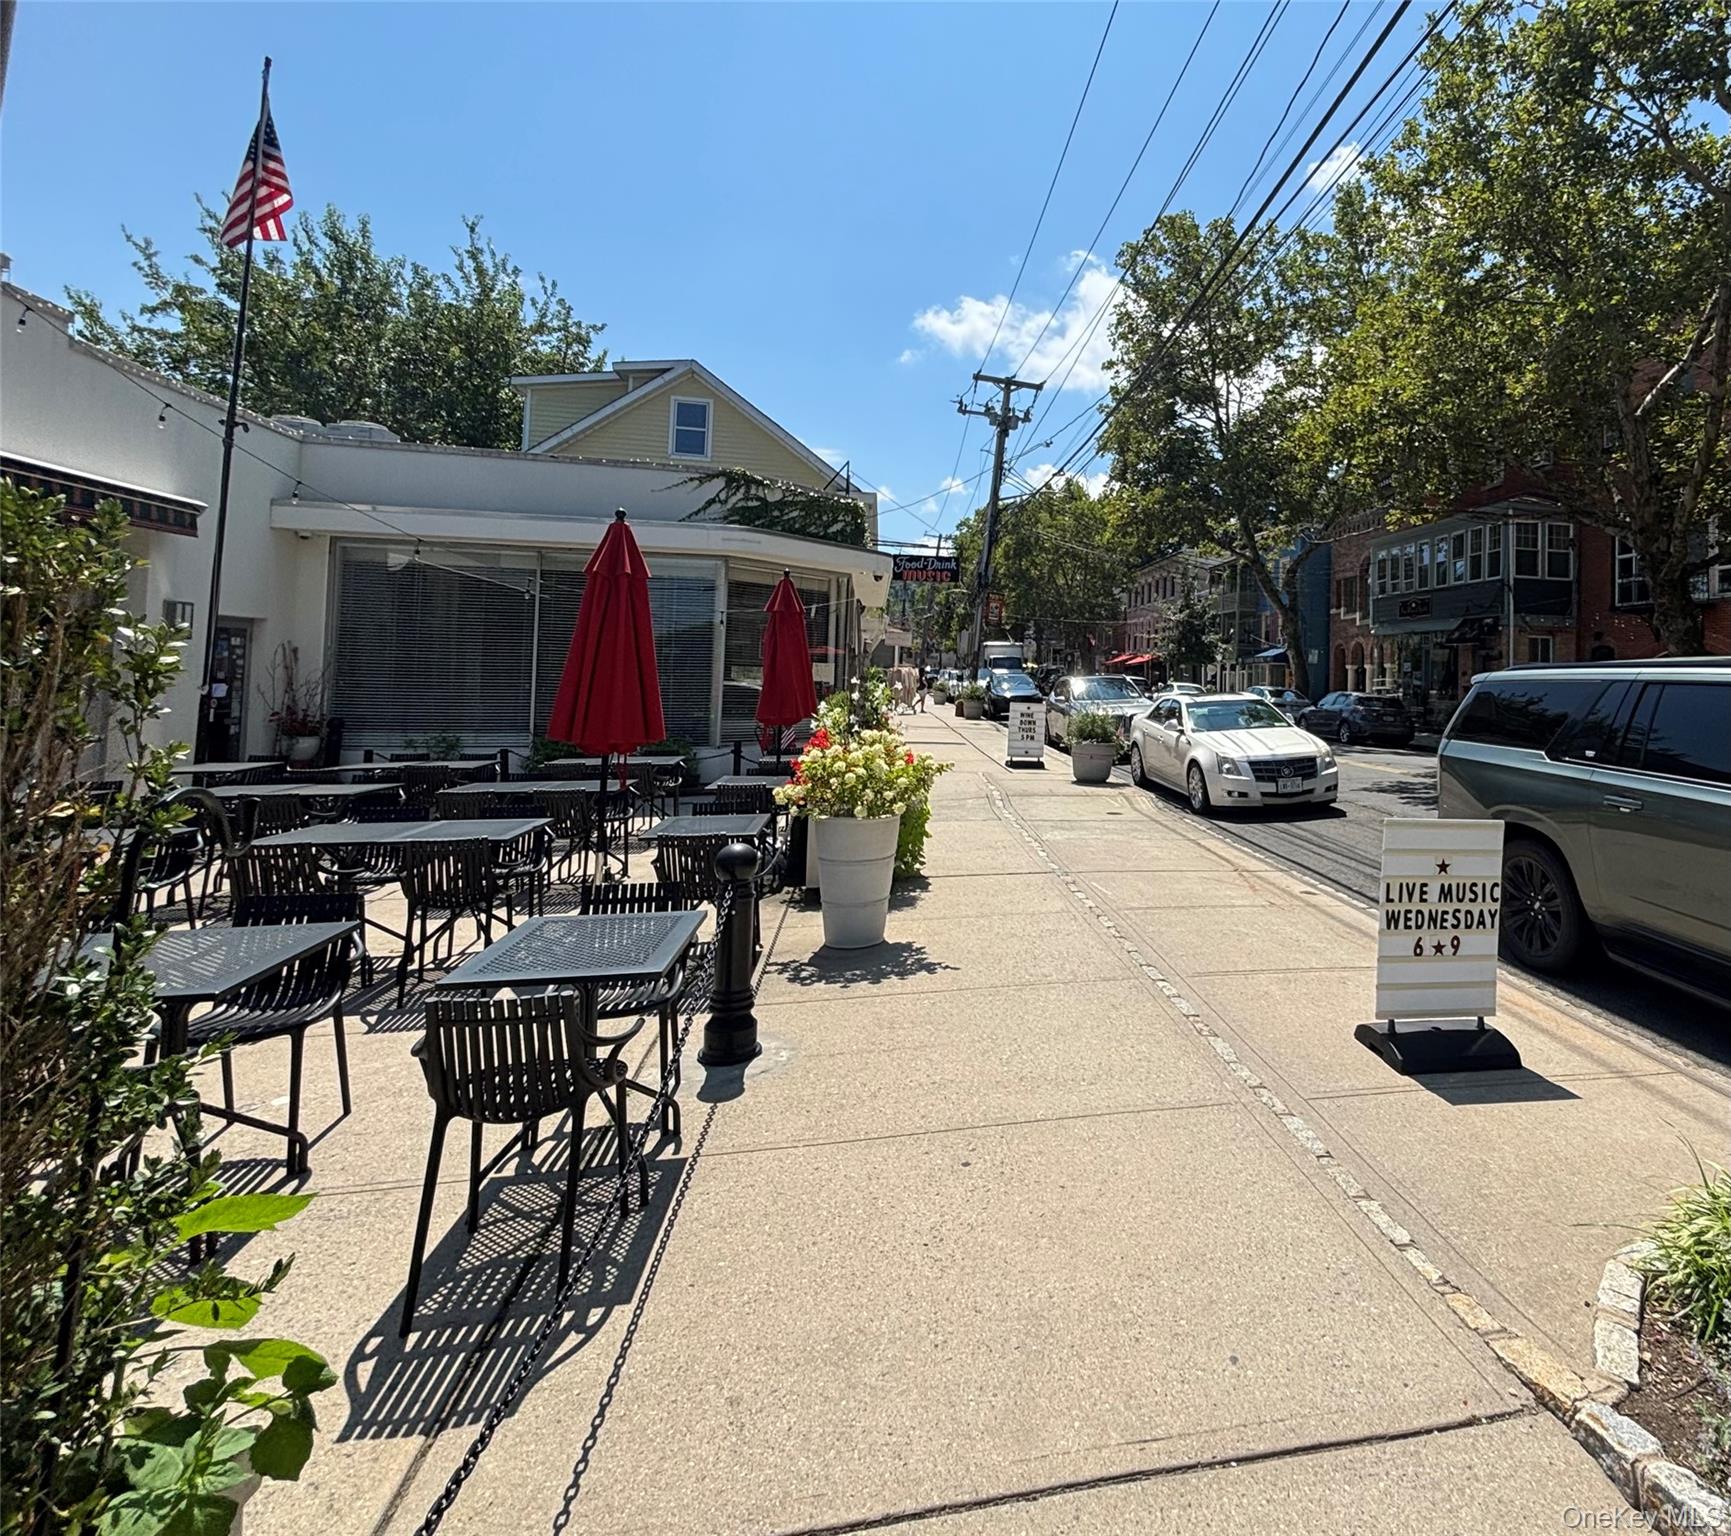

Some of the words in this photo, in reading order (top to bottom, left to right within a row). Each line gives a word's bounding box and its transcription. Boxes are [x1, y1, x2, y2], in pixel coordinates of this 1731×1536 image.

[1385, 882, 1429, 903] LIVE
[1438, 882, 1500, 903] MUSIC
[1385, 908, 1499, 930] WEDNESDAY
[1413, 936, 1424, 957] 6
[1450, 935, 1461, 956] 9
